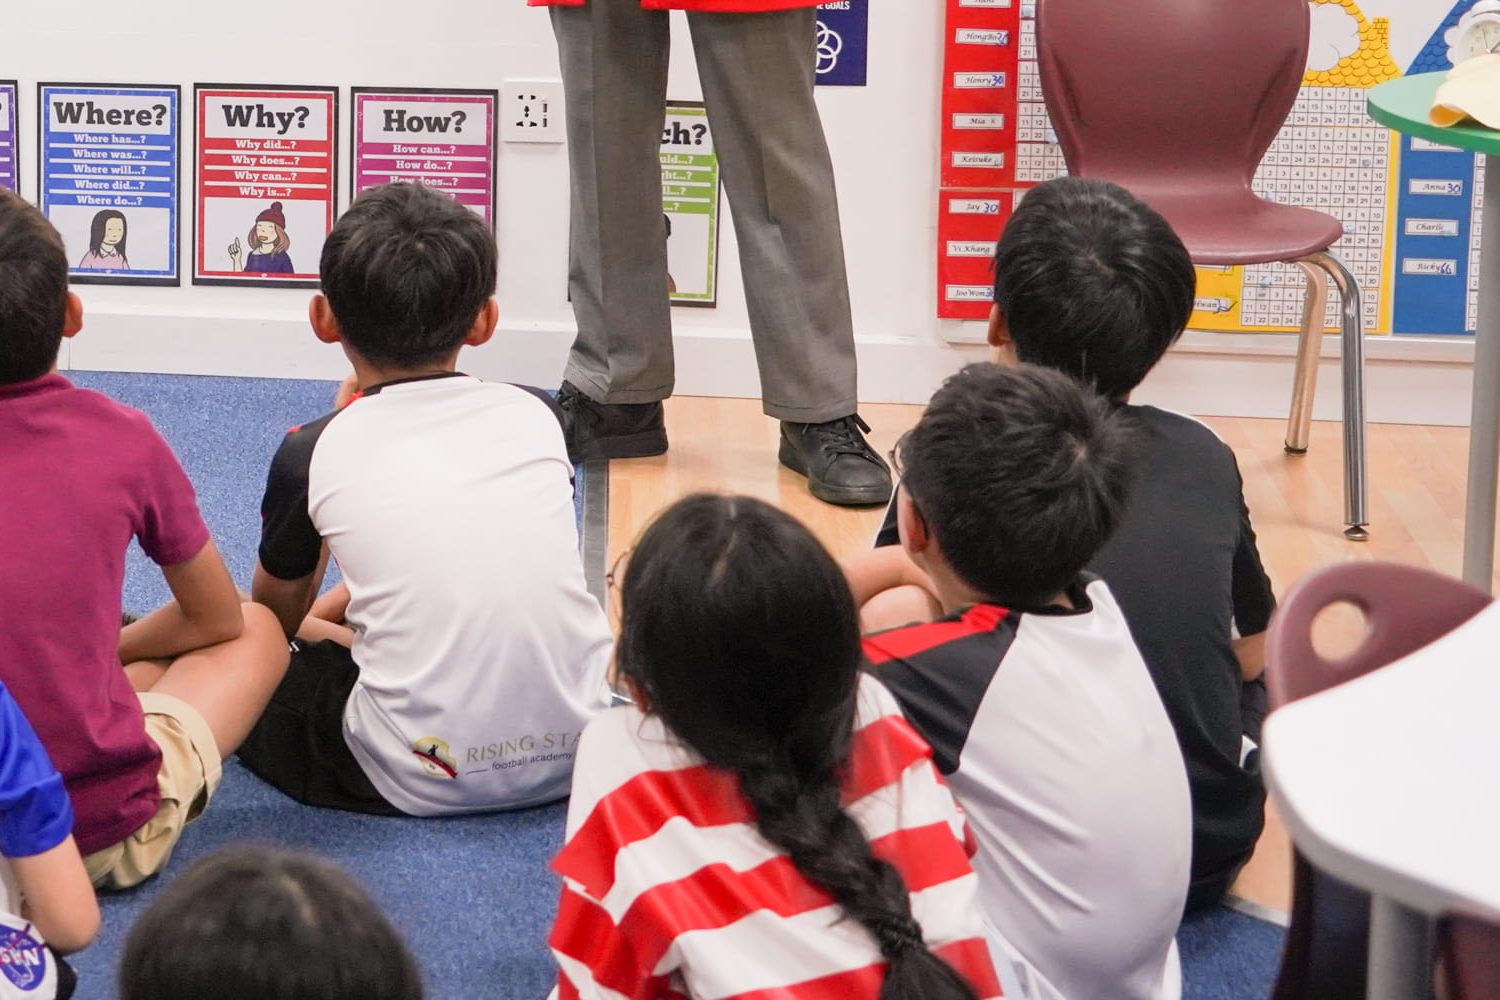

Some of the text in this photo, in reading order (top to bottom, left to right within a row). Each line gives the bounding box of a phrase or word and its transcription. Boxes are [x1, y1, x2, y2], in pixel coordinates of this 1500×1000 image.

[825, 0, 850, 10] GOALS
[965, 76, 991, 85] Henry
[53, 101, 167, 126] Where?
[222, 104, 310, 134] Why?
[383, 109, 467, 133] How?
[73, 133, 146, 144] Where has...?
[661, 121, 707, 146] ch?
[235, 139, 297, 150] Why did...?
[393, 144, 456, 154] How can...?
[73, 149, 147, 159] Where was...?
[231, 155, 300, 166] Why does...?
[395, 160, 453, 170] How do...?
[73, 164, 147, 175] Where will...?
[234, 171, 297, 181] Why can...?
[74, 179, 145, 190] Where did...?
[1447, 182, 1461, 193] 30
[239, 187, 292, 197] Why is...?
[76, 195, 143, 206] Where do...?
[983, 202, 999, 213] 30
[963, 245, 990, 255] Khang
[1417, 263, 1440, 272] Ricky
[466, 735, 535, 763] RISING
[491, 752, 573, 770] football academy
